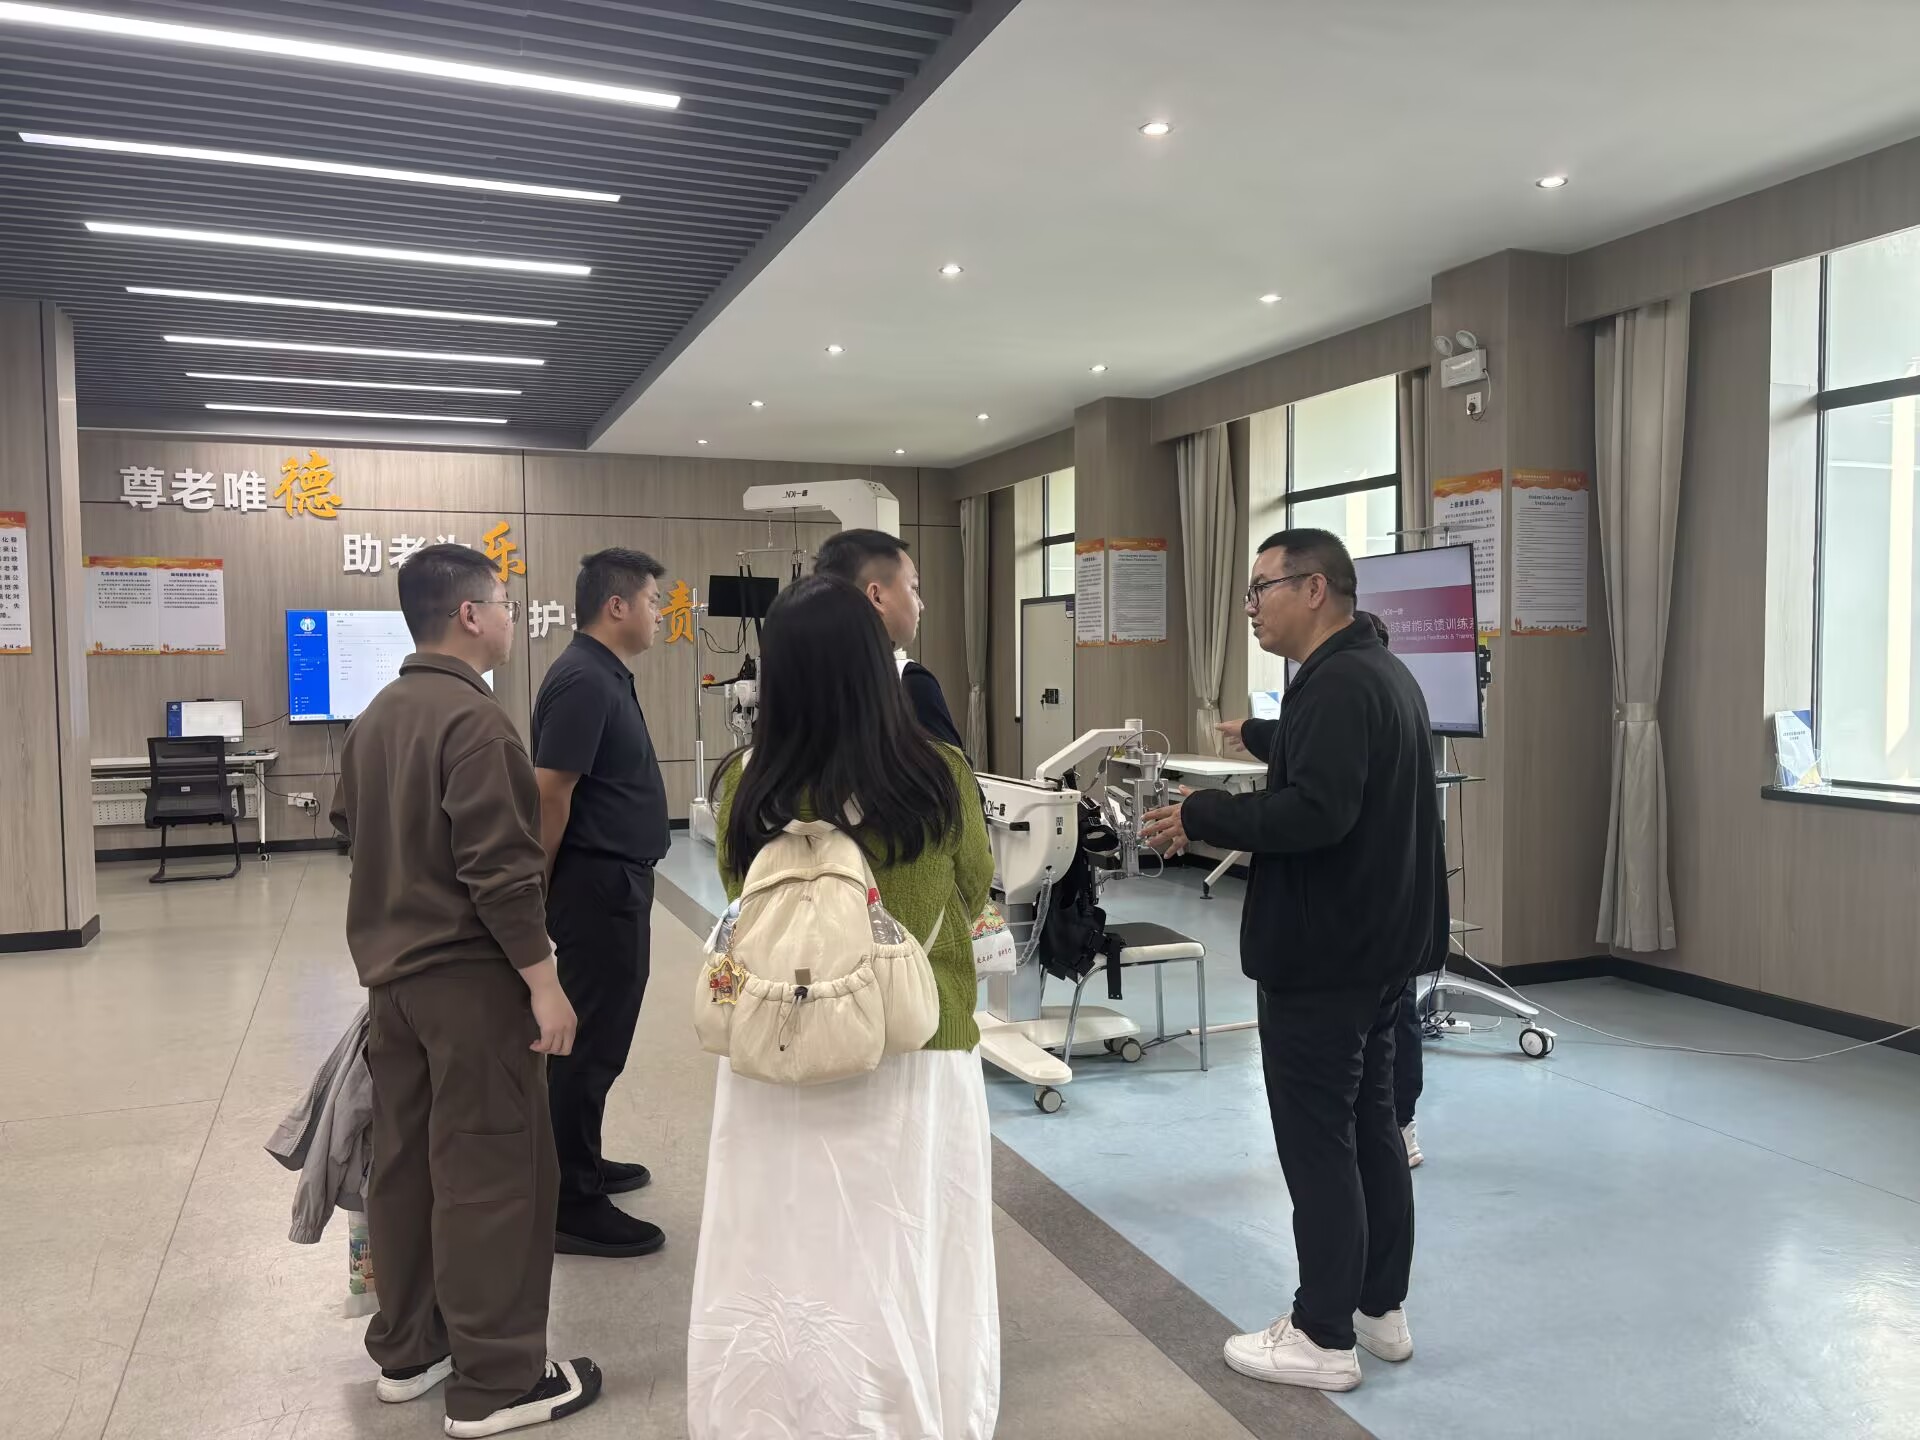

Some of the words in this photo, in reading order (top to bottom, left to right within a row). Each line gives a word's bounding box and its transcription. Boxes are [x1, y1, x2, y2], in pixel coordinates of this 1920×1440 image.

[119, 450, 343, 518] 尊老唯德
[343, 521, 526, 583] 助老乐
